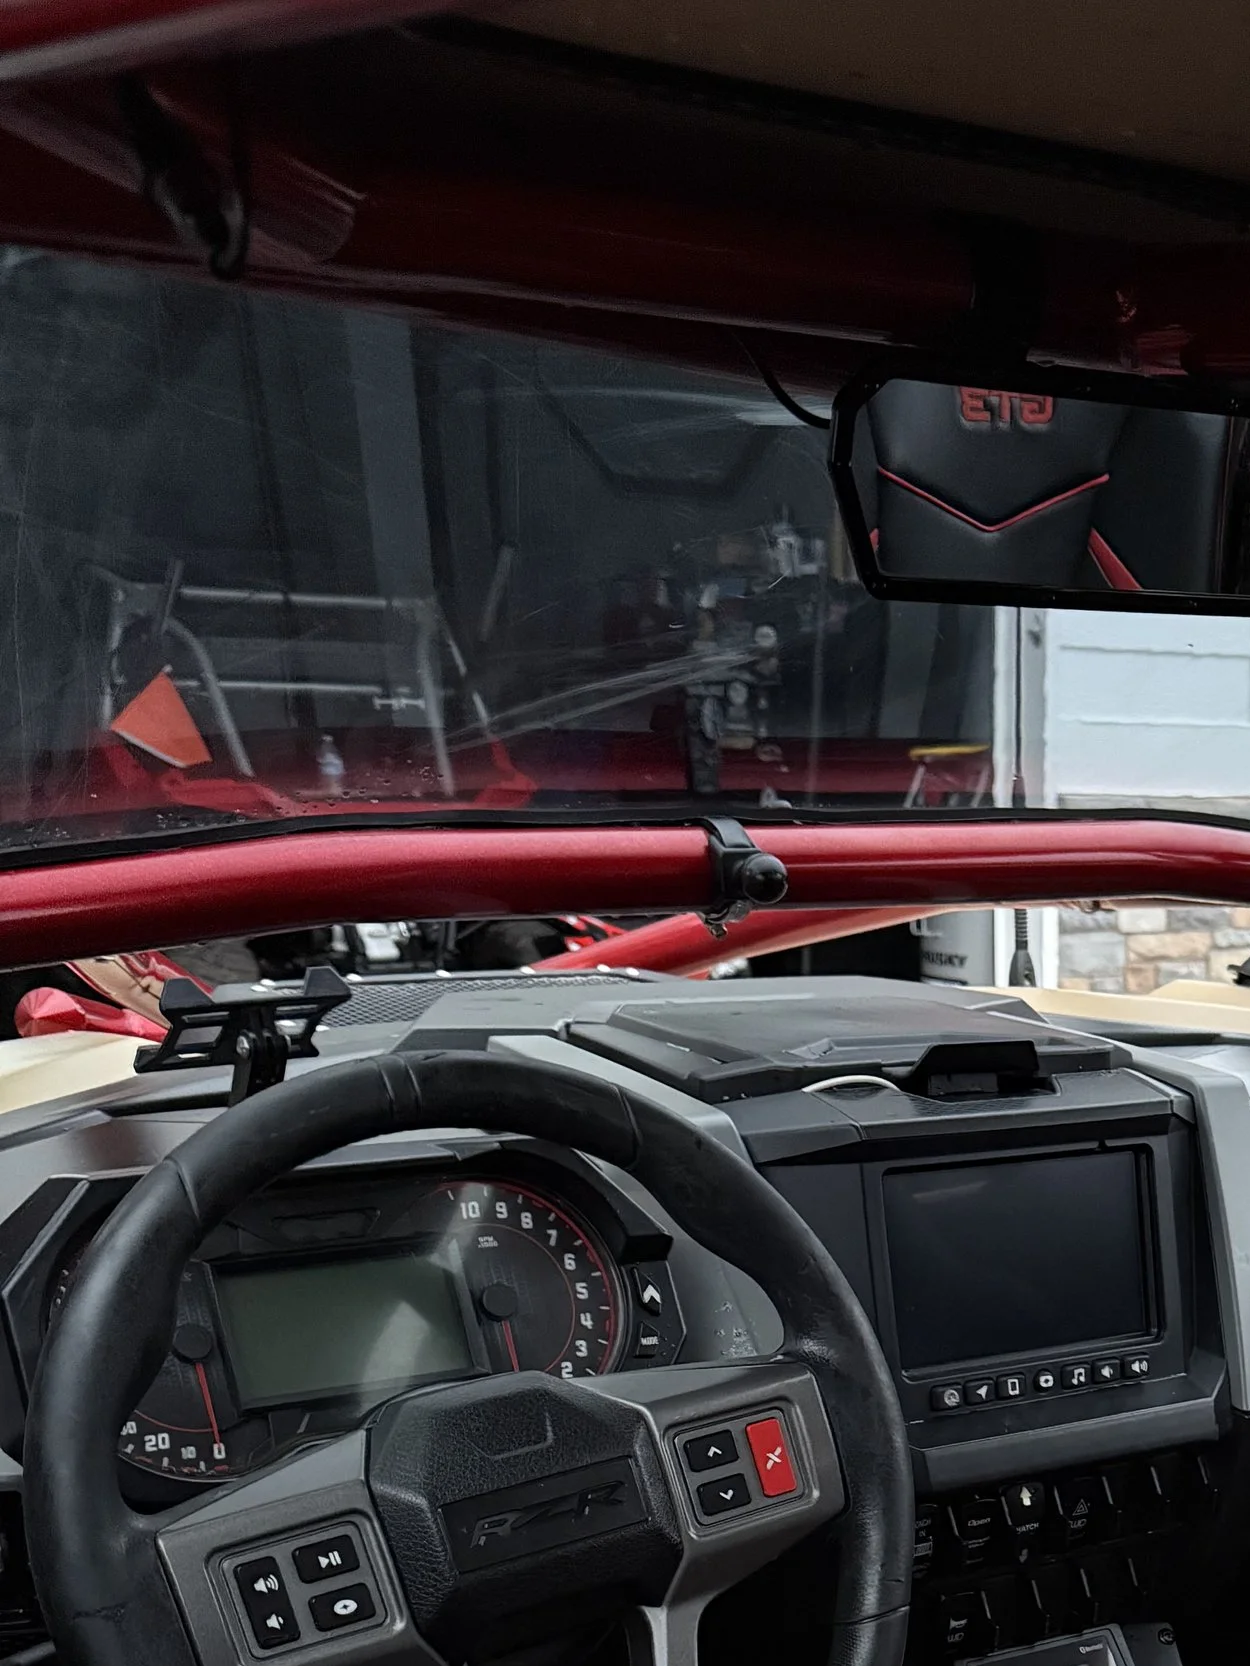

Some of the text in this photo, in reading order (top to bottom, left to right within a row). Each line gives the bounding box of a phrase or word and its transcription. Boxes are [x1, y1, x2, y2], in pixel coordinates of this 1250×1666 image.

[460, 1201, 481, 1219] 10
[495, 1201, 508, 1219] 9
[520, 1211, 533, 1229] 8
[546, 1229, 558, 1246] 7
[564, 1253, 577, 1270] 6
[575, 1282, 589, 1300] 5
[579, 1311, 593, 1329] 4
[575, 1339, 588, 1357] 3
[560, 1361, 573, 1378] 2
[144, 1432, 170, 1452] 20
[213, 1442, 226, 1459] 0
[180, 1446, 197, 1459] 10
